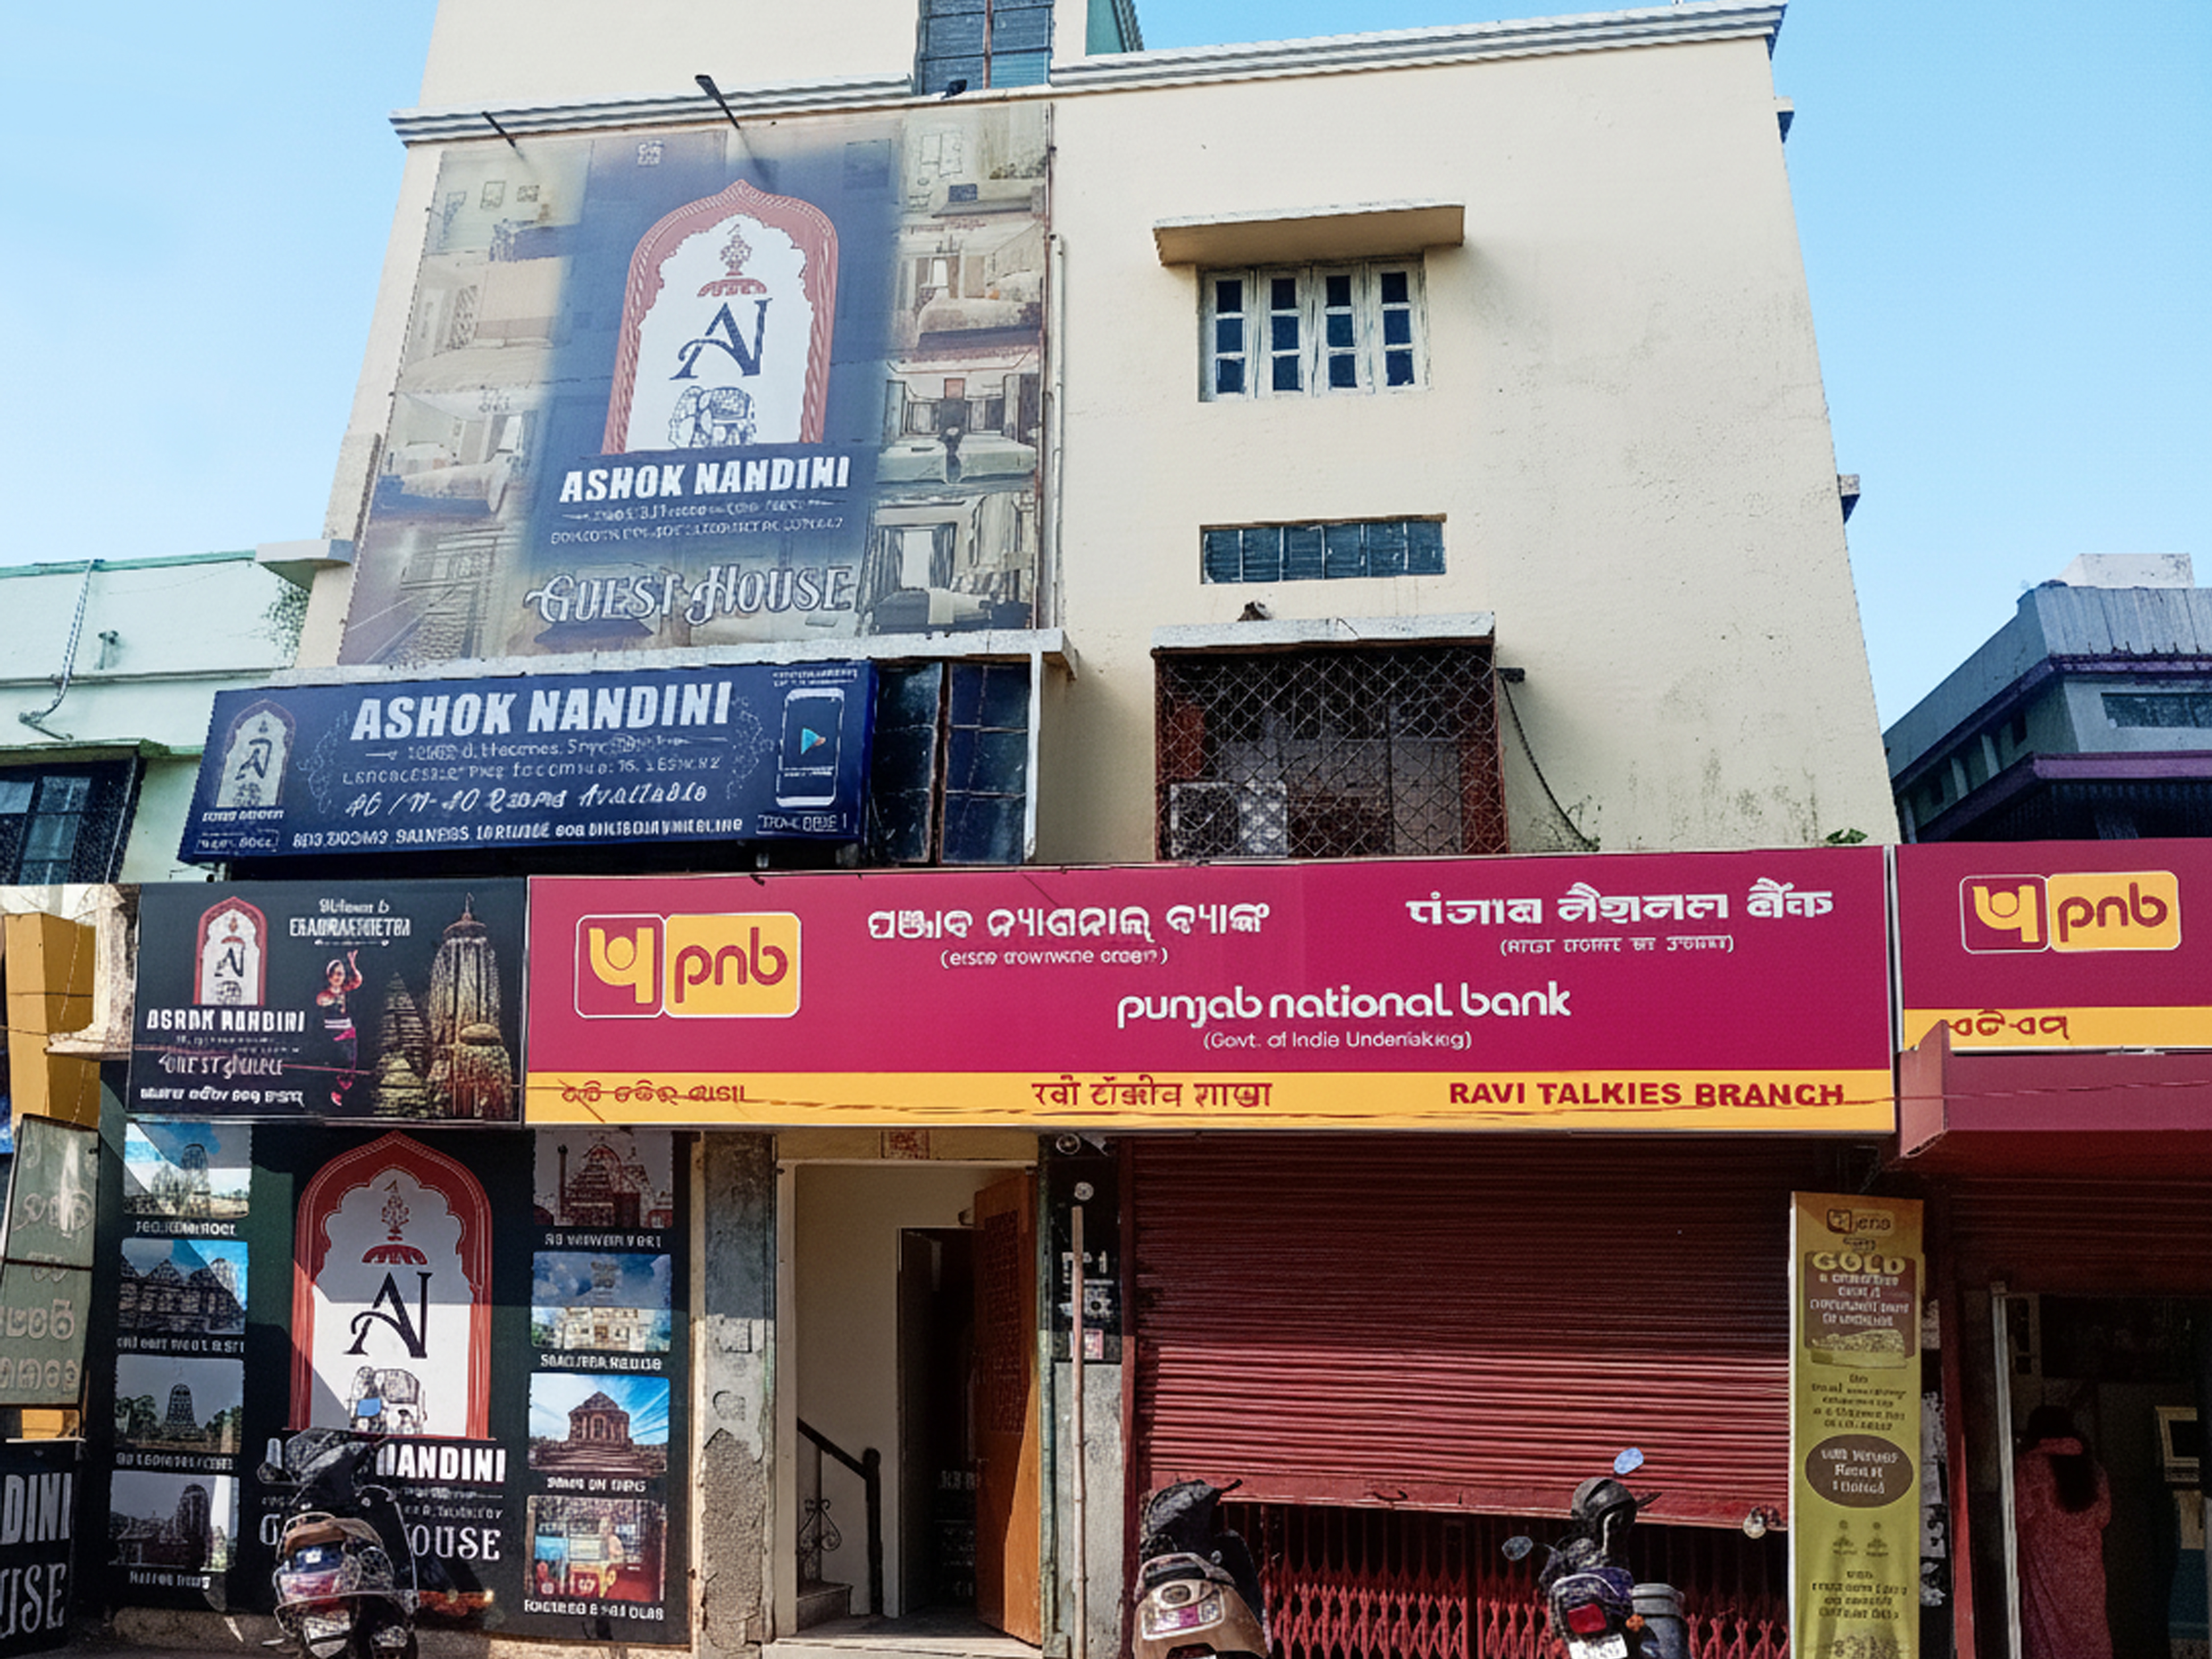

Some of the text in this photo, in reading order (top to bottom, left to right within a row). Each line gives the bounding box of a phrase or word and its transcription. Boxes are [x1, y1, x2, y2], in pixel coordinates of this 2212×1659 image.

[559, 464, 686, 502] ASHOK
[685, 564, 853, 627] HOUSE
[350, 681, 733, 741] ASHOK NANDINI
[1405, 891, 1543, 925] पंजाब
[2057, 882, 2168, 943] pnb
[674, 926, 789, 1005] pnb
[1117, 980, 1572, 1029] punjab national bank
[1449, 1083, 1845, 1107] RAVI TALKIES BRANCH
[1812, 1252, 1906, 1275] GOLD
[411, 1523, 501, 1560] OUSE
